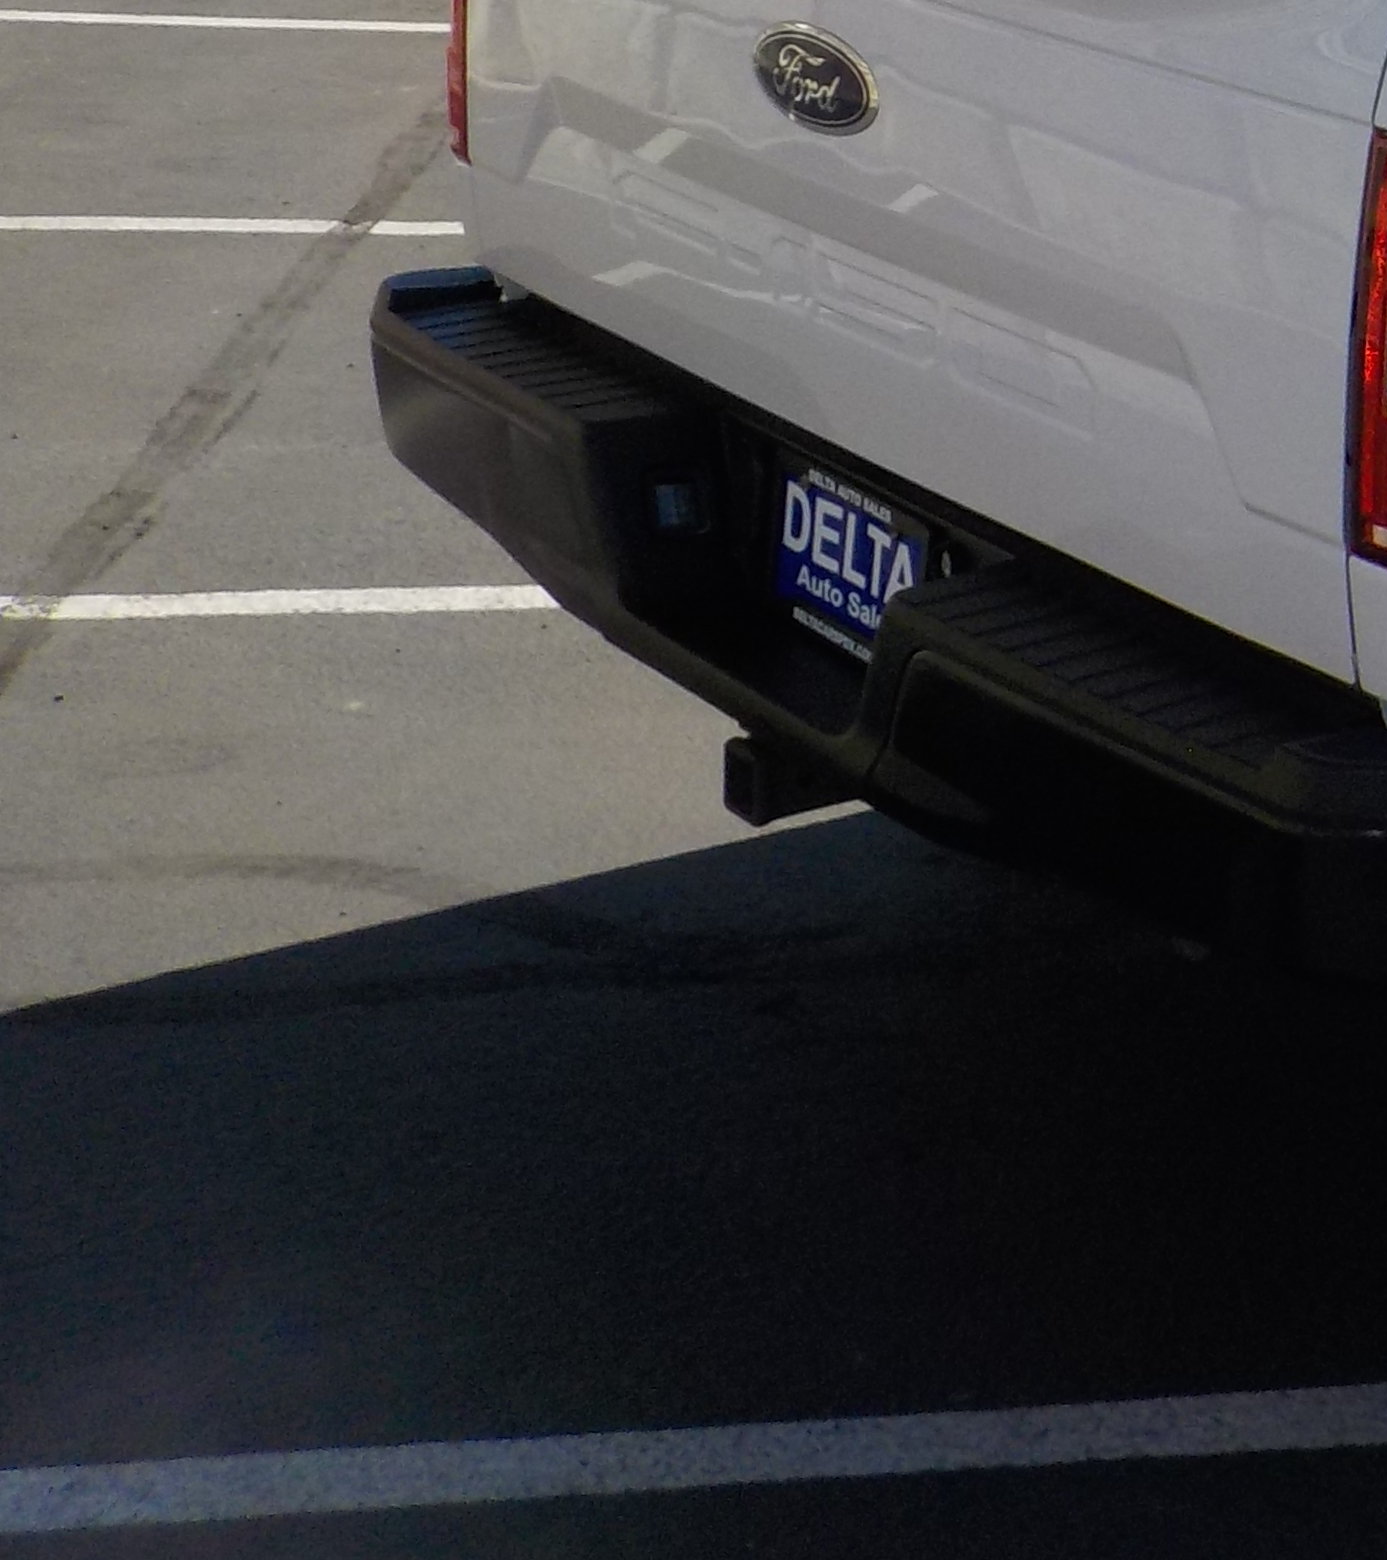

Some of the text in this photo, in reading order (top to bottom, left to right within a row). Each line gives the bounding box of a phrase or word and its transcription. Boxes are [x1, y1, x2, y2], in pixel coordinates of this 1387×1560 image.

[772, 43, 841, 114] Ford
[782, 479, 914, 603] DELTA
[796, 564, 843, 608] Auto
